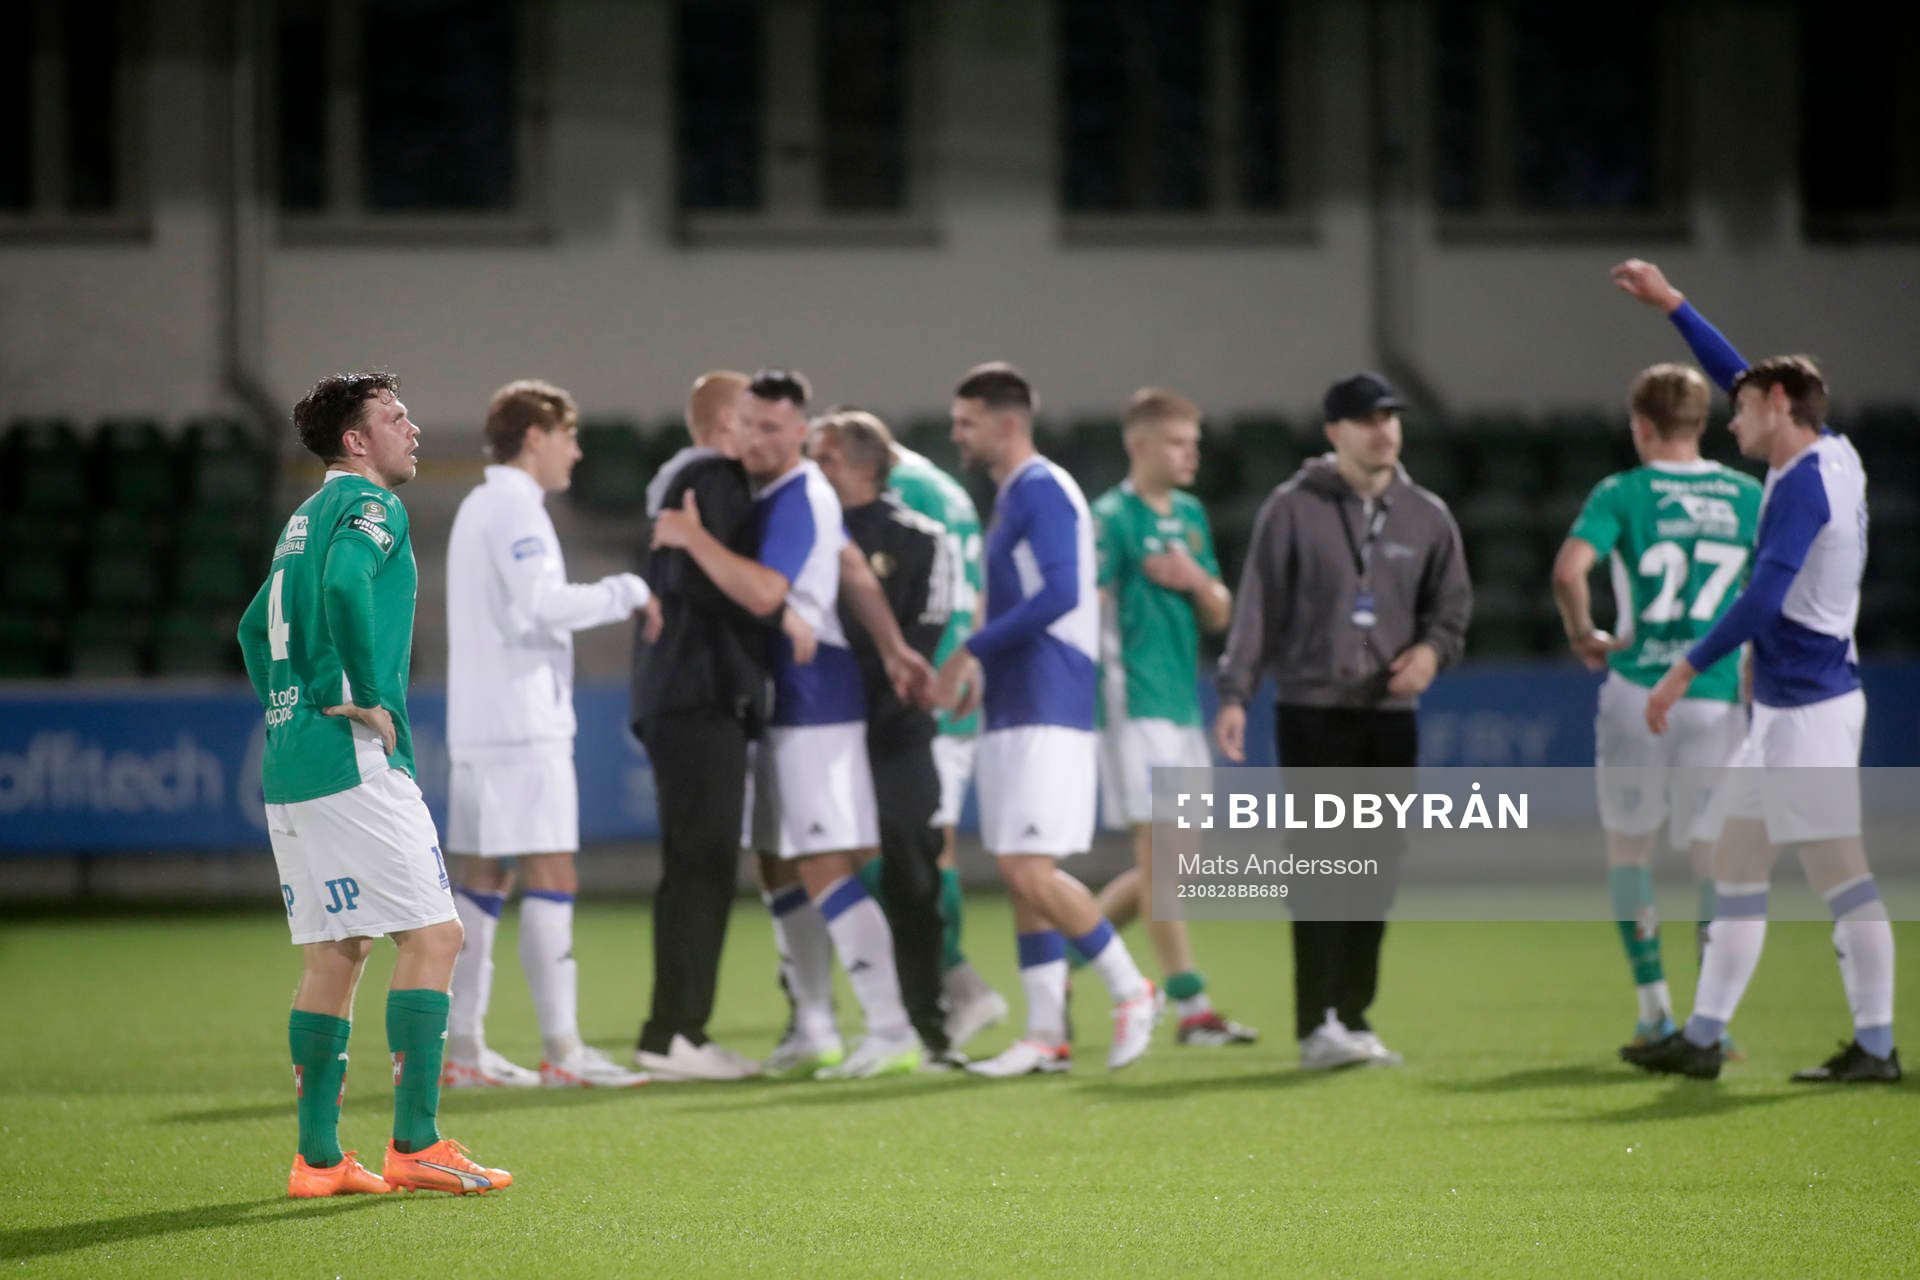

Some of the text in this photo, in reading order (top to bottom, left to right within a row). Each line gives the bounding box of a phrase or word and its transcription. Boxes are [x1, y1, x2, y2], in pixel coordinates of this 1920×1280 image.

[354, 518, 391, 545] UNIBET
[1638, 539, 1747, 622] 27
[268, 568, 289, 661] 4
[325, 877, 360, 914] JP
